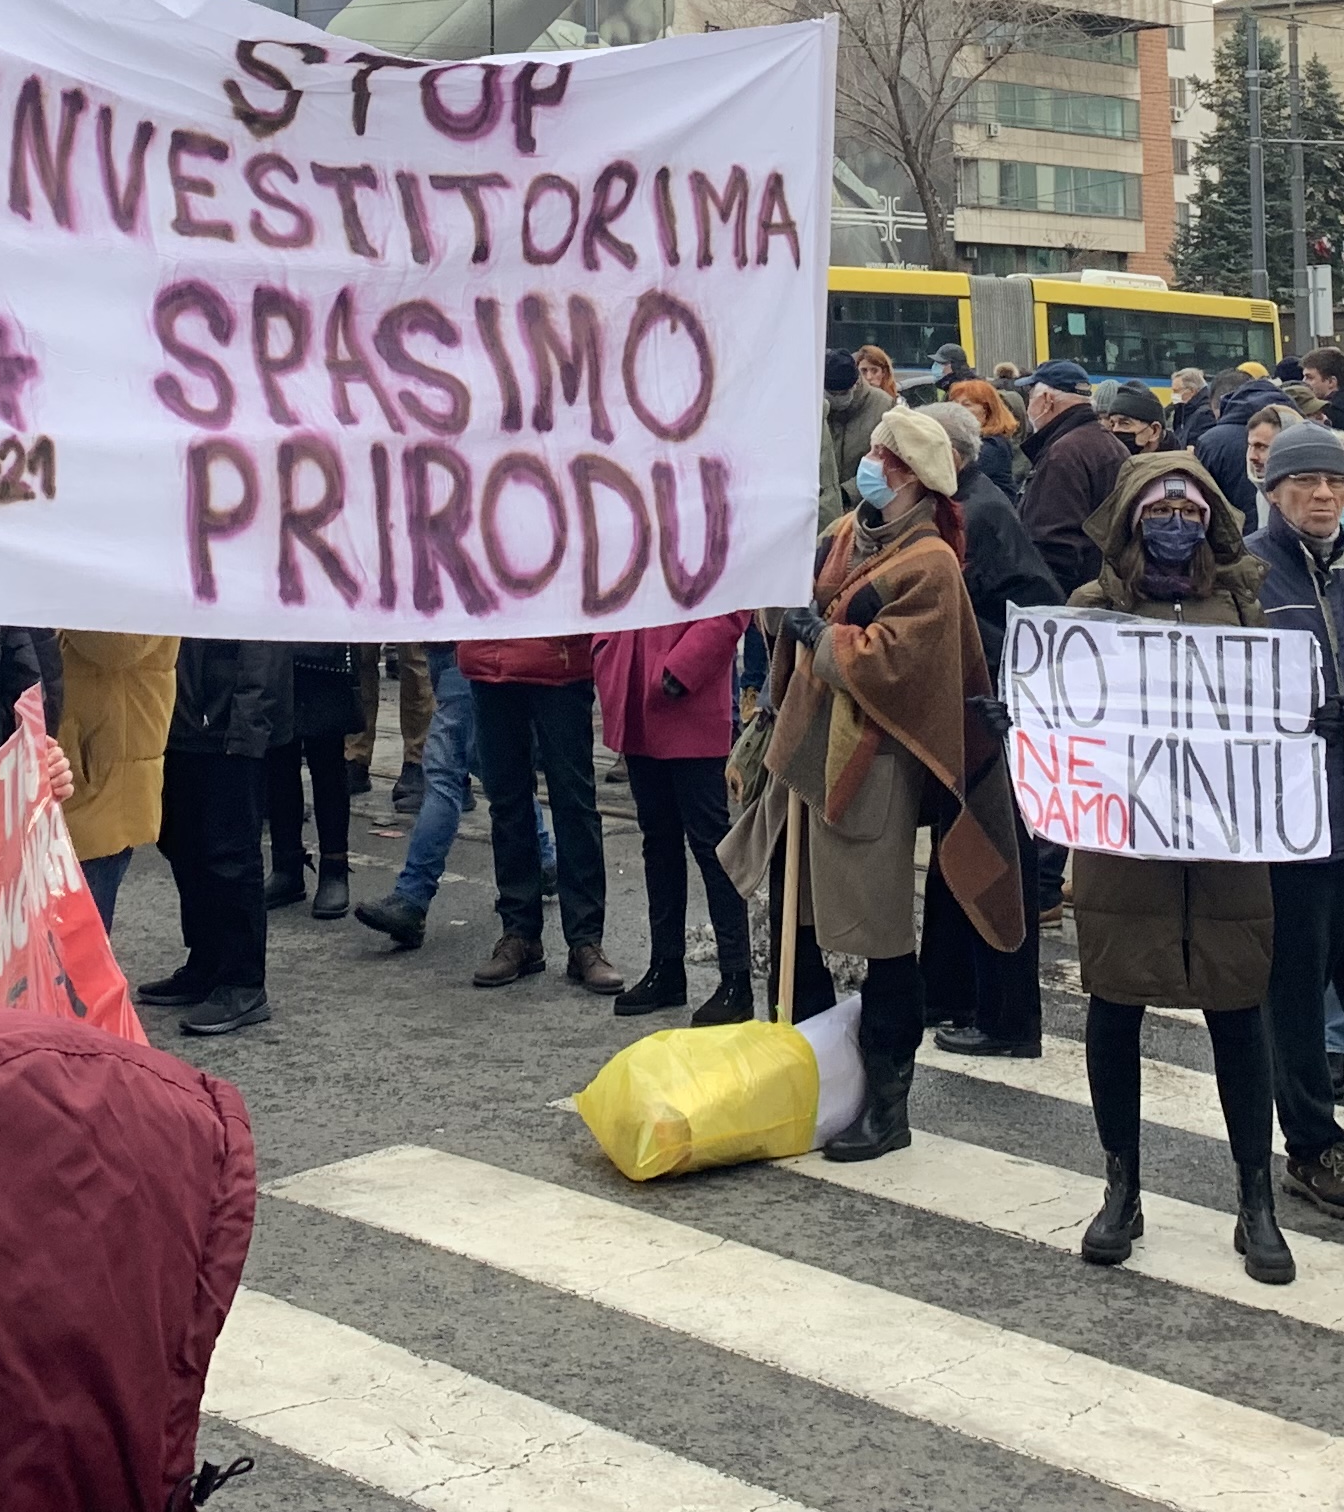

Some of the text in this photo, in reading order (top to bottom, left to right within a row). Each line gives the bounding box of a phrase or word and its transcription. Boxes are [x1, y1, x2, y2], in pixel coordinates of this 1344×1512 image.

[222, 38, 571, 155] STOP
[153, 278, 715, 444] SPASIMO
[184, 430, 731, 618] PRIRODU
[1010, 618, 1322, 740] RIO TINTU
[1016, 728, 1107, 789] NE
[1016, 780, 1129, 850] DAMO
[1127, 731, 1324, 855] KINTU
